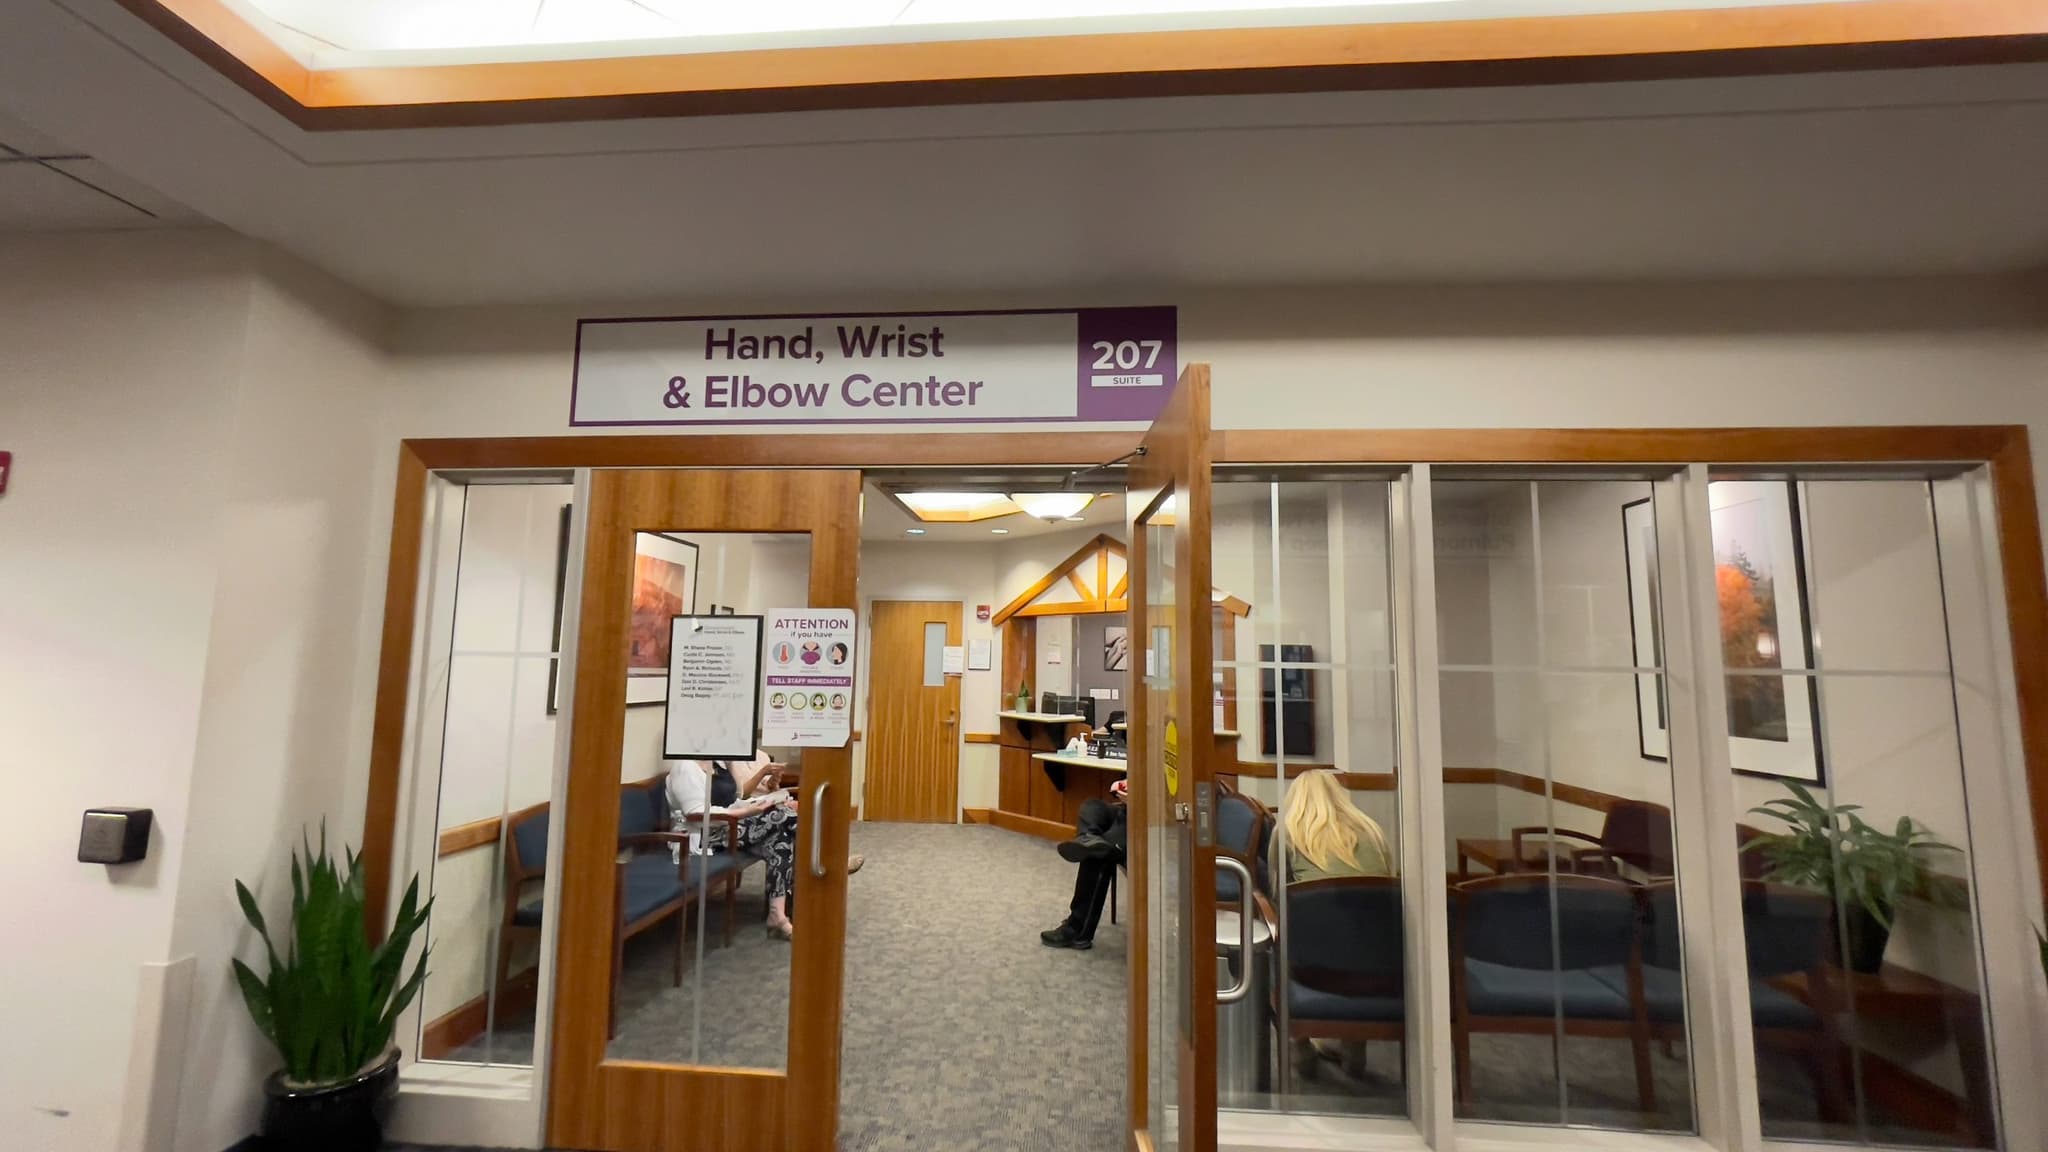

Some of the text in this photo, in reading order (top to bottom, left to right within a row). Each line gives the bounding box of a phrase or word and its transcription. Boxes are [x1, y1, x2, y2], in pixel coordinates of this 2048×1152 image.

[704, 324, 945, 364] Hand, Wrist
[1092, 340, 1162, 369] 207
[1113, 376, 1141, 385] SUITE
[662, 373, 984, 408] & Elbow Center
[775, 619, 849, 629] ATTENTION
[807, 678, 847, 686] IMMEDIATELY
